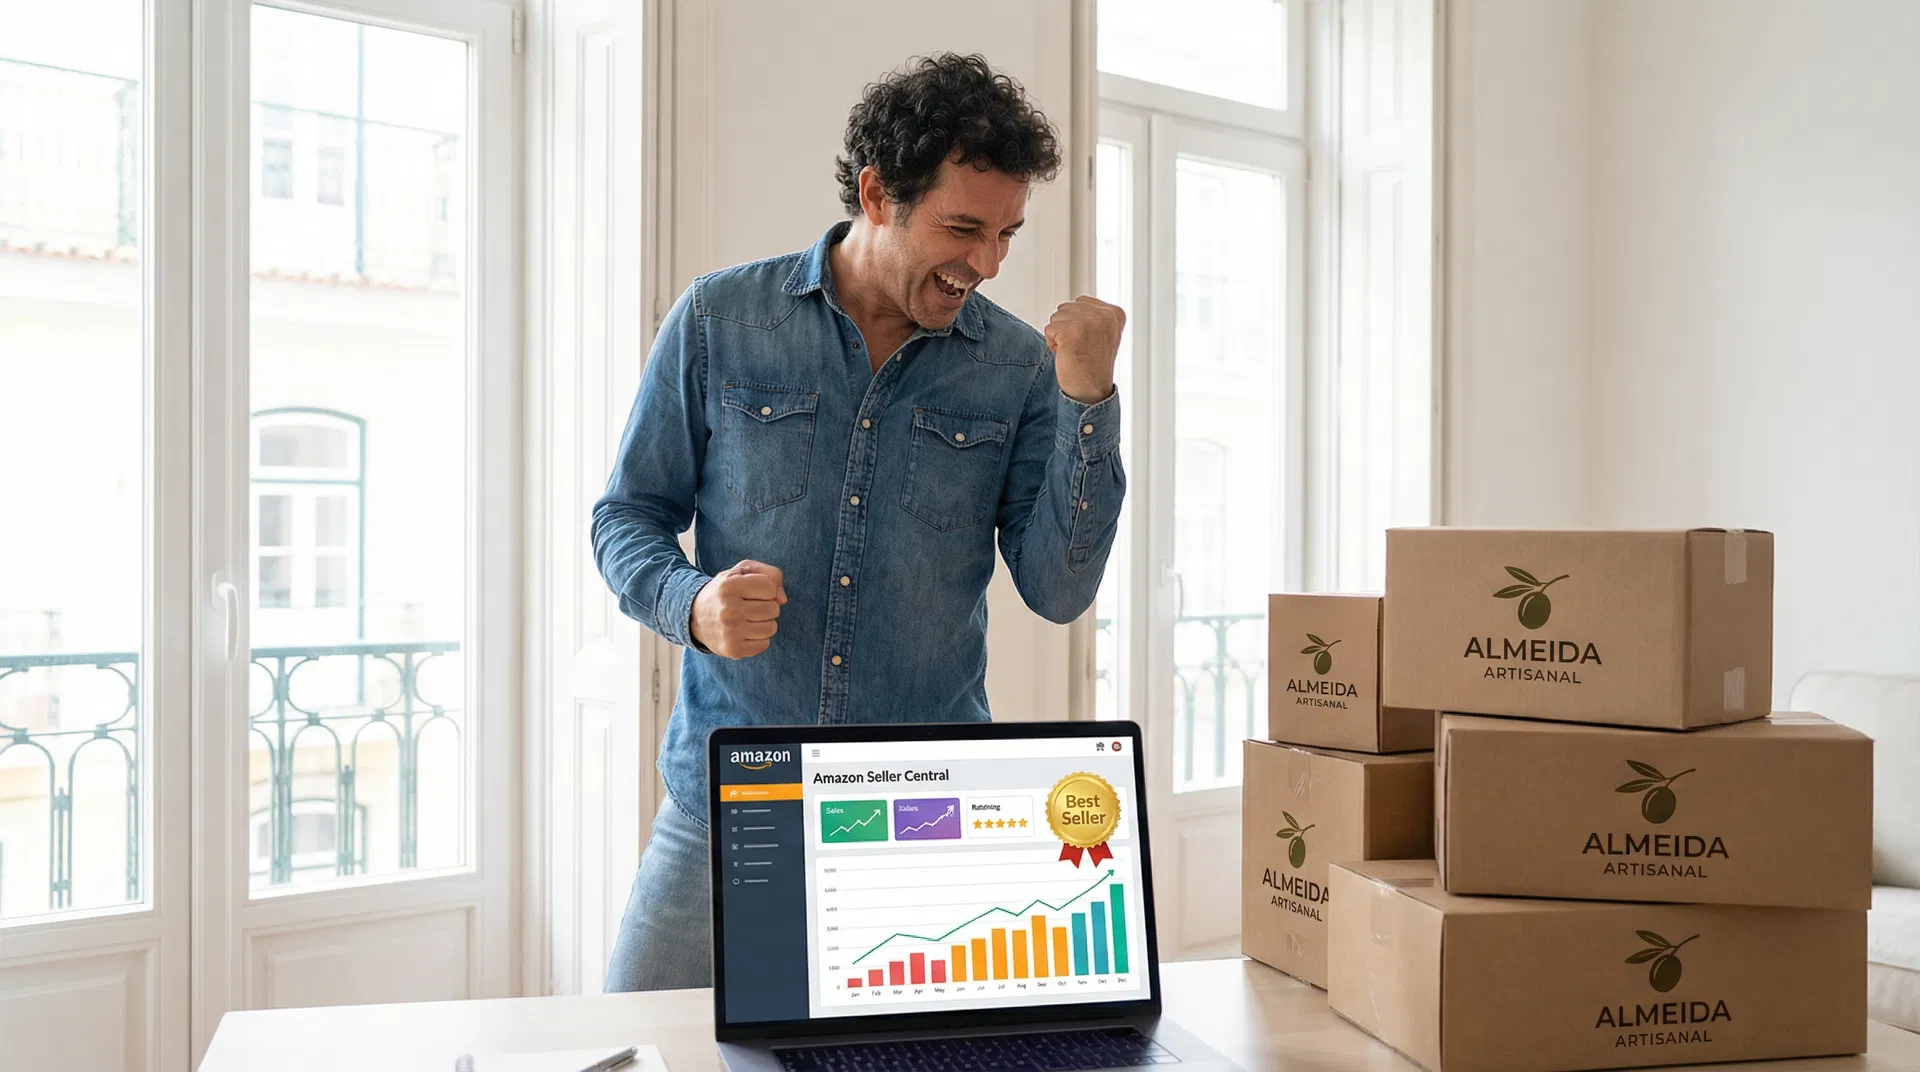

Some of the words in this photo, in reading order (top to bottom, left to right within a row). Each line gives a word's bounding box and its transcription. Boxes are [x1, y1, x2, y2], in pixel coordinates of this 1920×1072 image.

[1463, 636, 1602, 666] ALMEIDA
[1484, 666, 1582, 684] ARTISANAL
[1286, 678, 1359, 699] ALMEIDA
[1295, 696, 1349, 710] ARTISANAL
[730, 750, 791, 764] amazon
[812, 772, 864, 785] Amazon
[866, 769, 902, 783] Seller
[904, 768, 950, 782] Central
[825, 806, 845, 815] Sales
[1065, 794, 1101, 809] Best
[1061, 811, 1107, 826] Seller
[1581, 832, 1730, 860] ALMEIDA
[1603, 862, 1708, 879] ARTISANAL
[1262, 868, 1329, 905] ALMEIDA
[1270, 895, 1323, 923] ARTISANAL
[1595, 999, 1732, 1029] ALMEIDA
[1615, 1030, 1713, 1048] ARTISANAL
